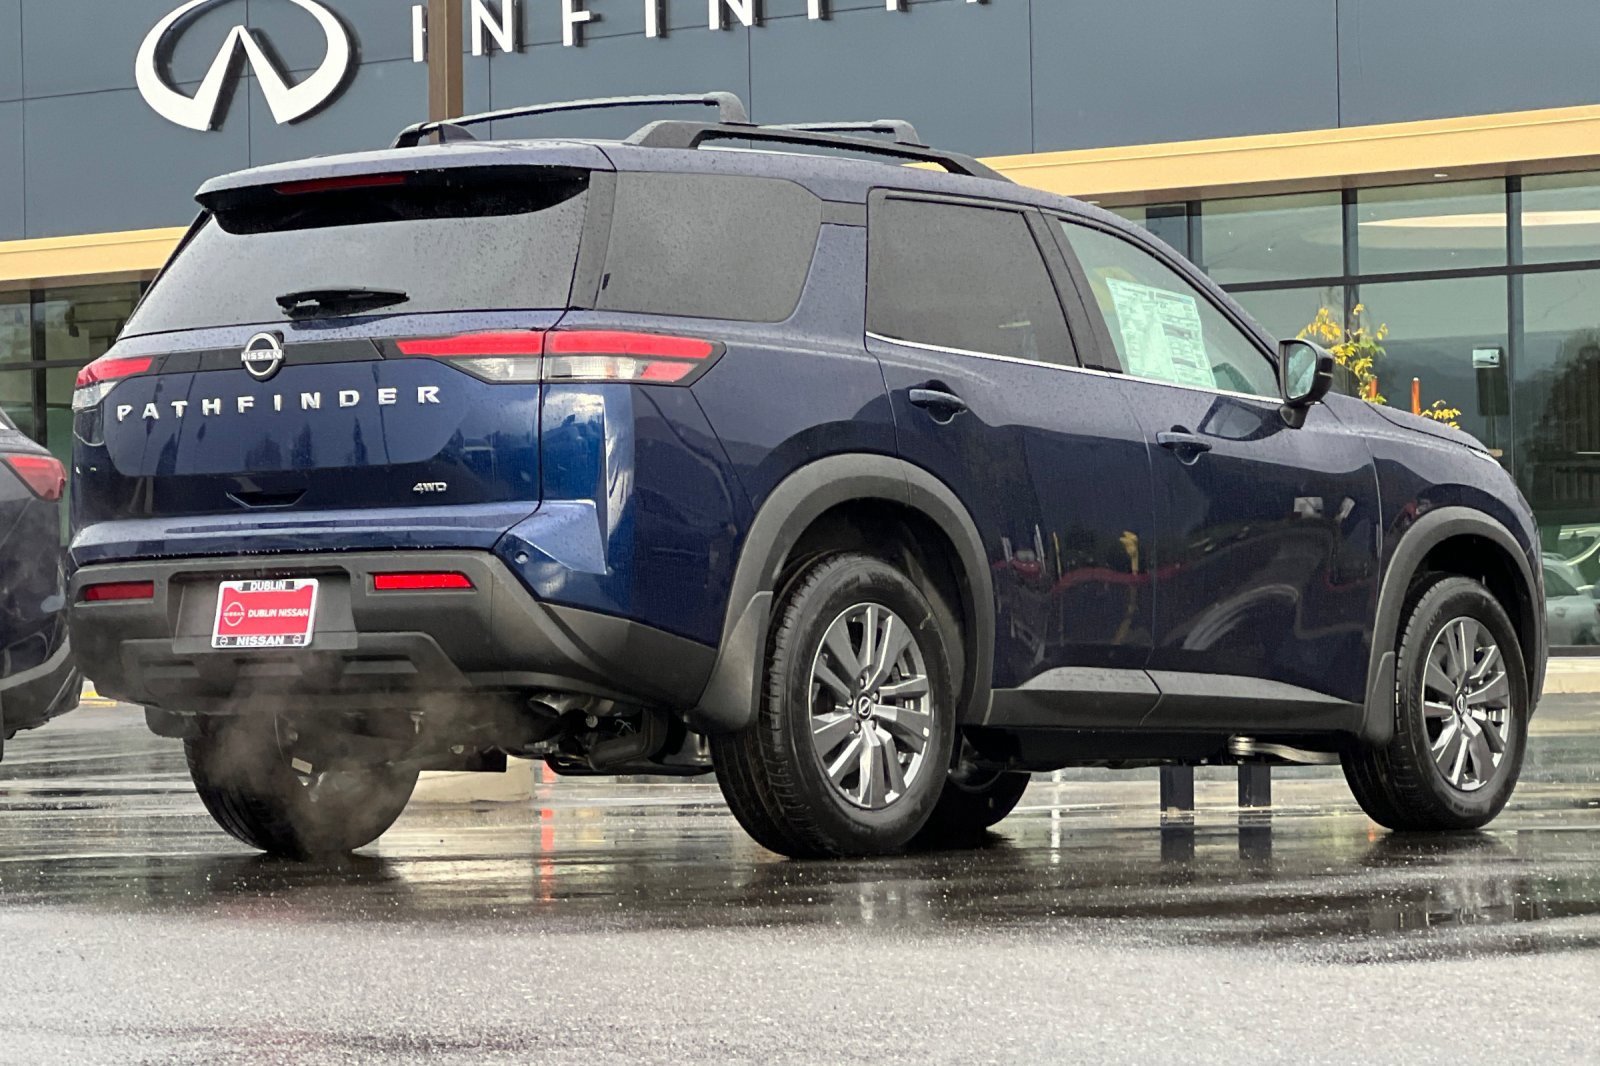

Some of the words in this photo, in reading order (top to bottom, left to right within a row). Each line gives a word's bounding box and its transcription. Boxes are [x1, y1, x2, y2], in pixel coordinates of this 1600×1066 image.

[412, 0, 977, 62] INFIN
[241, 349, 283, 361] NISSAN
[116, 386, 441, 421] PATHFINDER
[412, 482, 447, 494] 4WD
[250, 581, 286, 591] DUBLIN
[248, 609, 277, 618] DUBLIN
[278, 608, 309, 617] NISSAN
[236, 635, 285, 646] NISSAN
